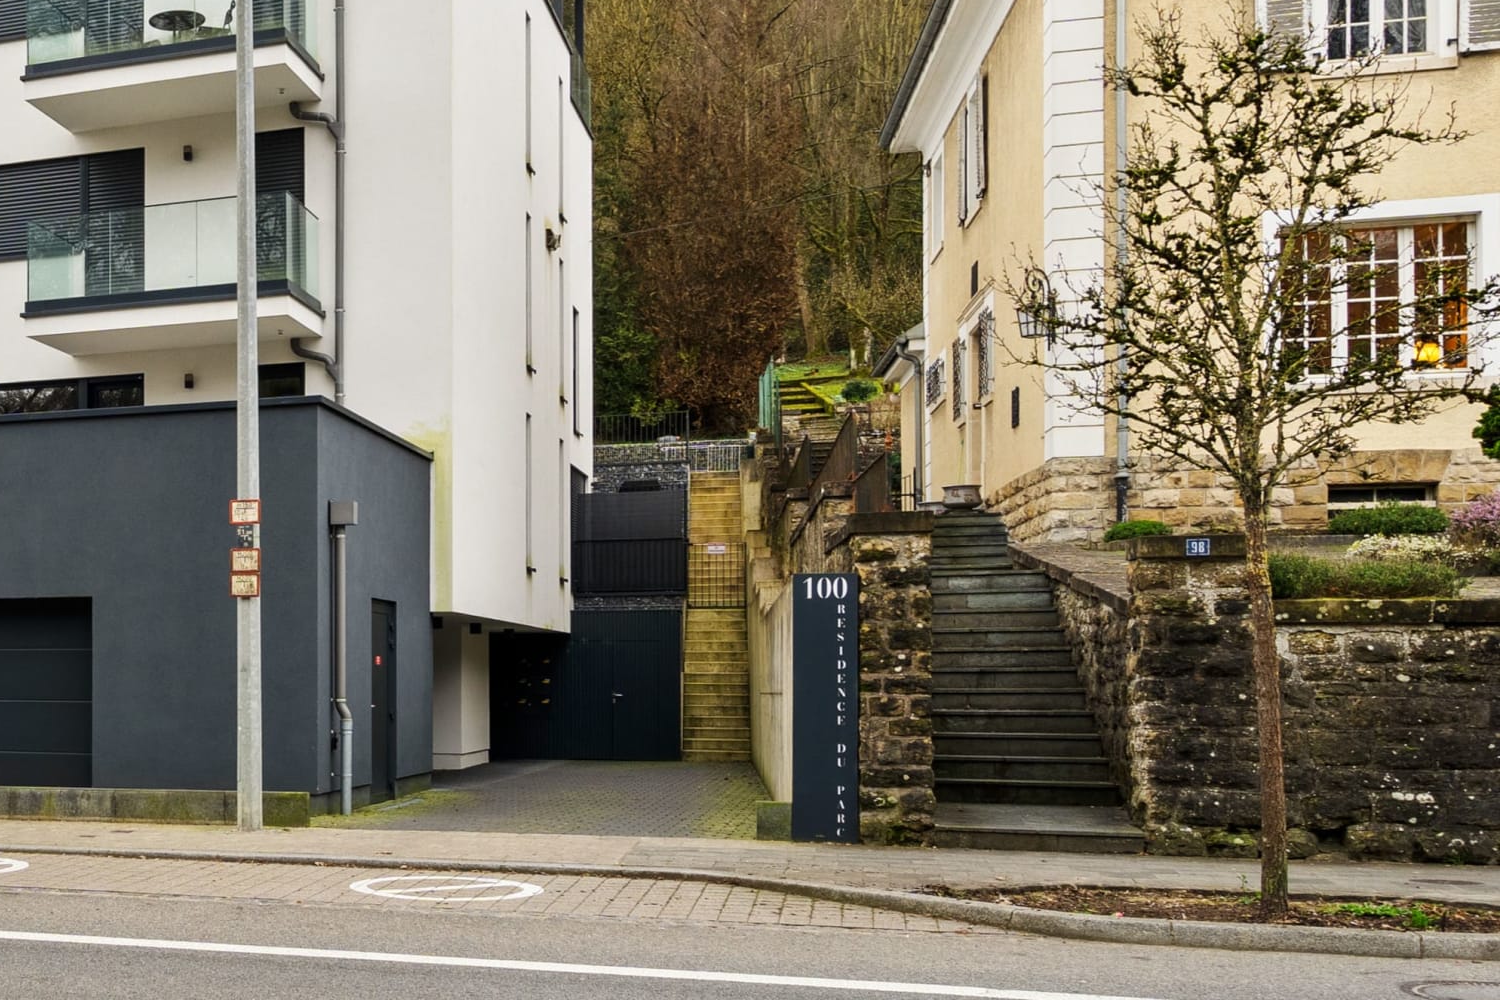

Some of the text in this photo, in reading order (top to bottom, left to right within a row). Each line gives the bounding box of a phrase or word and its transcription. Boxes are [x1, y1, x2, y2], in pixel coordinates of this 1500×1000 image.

[1191, 541, 1205, 553] 98
[802, 577, 848, 600] 100
[836, 604, 847, 837] RESIDENCE DU PARC
